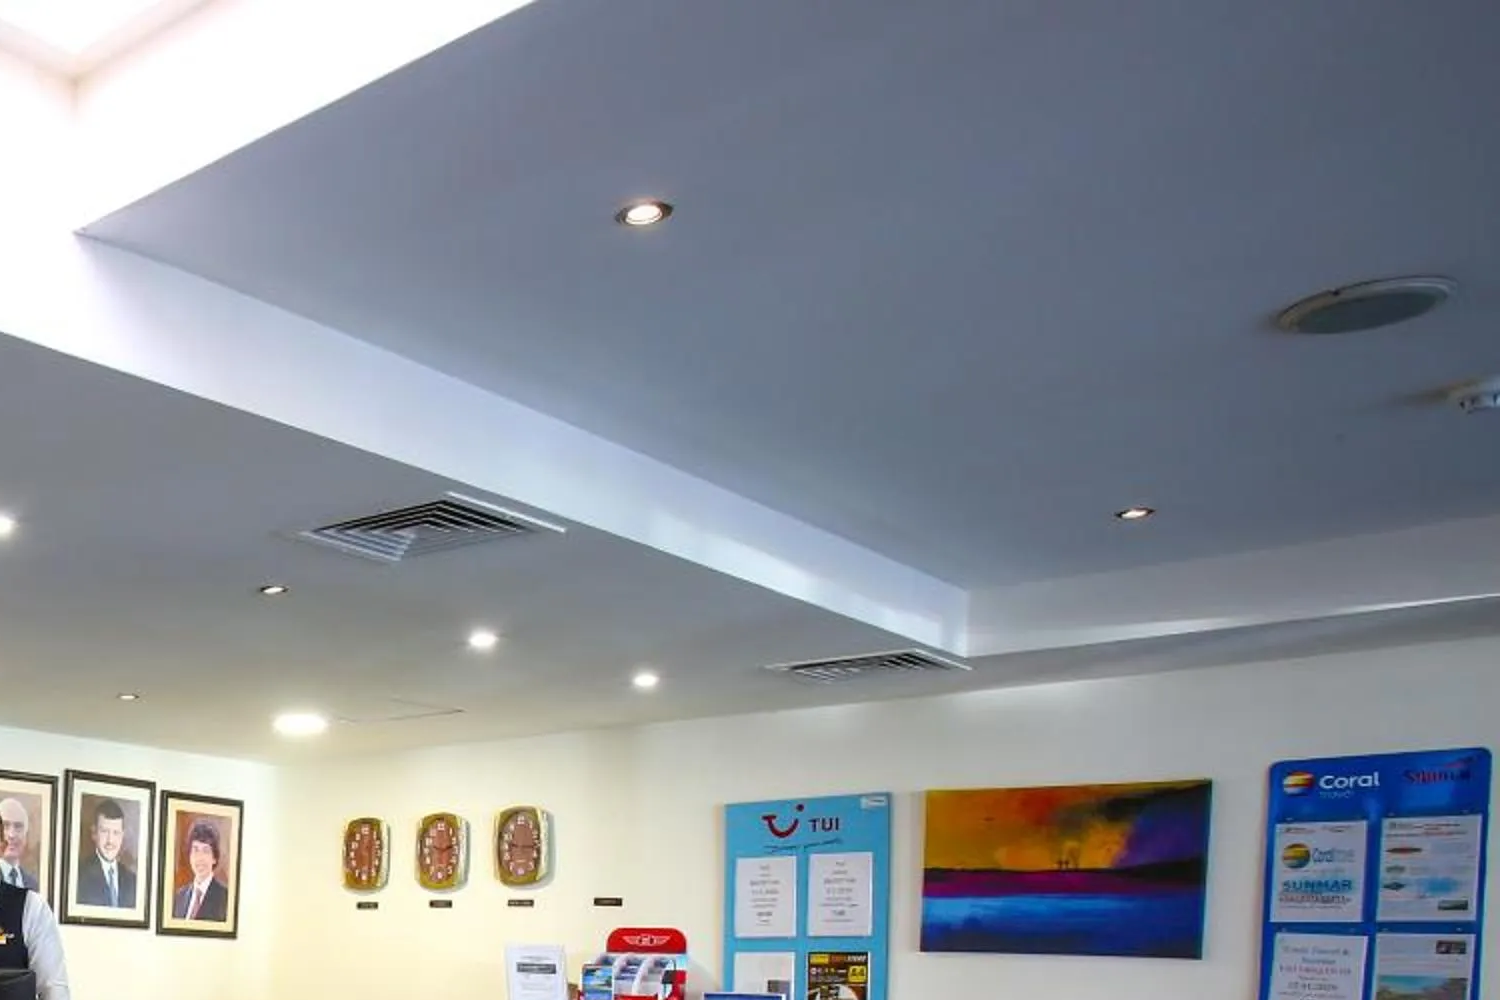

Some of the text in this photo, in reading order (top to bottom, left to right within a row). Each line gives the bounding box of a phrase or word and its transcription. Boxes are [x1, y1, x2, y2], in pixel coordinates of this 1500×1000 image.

[1319, 771, 1380, 789] Coral
[808, 817, 839, 832] TUI
[1283, 879, 1353, 894] SUNMAR
